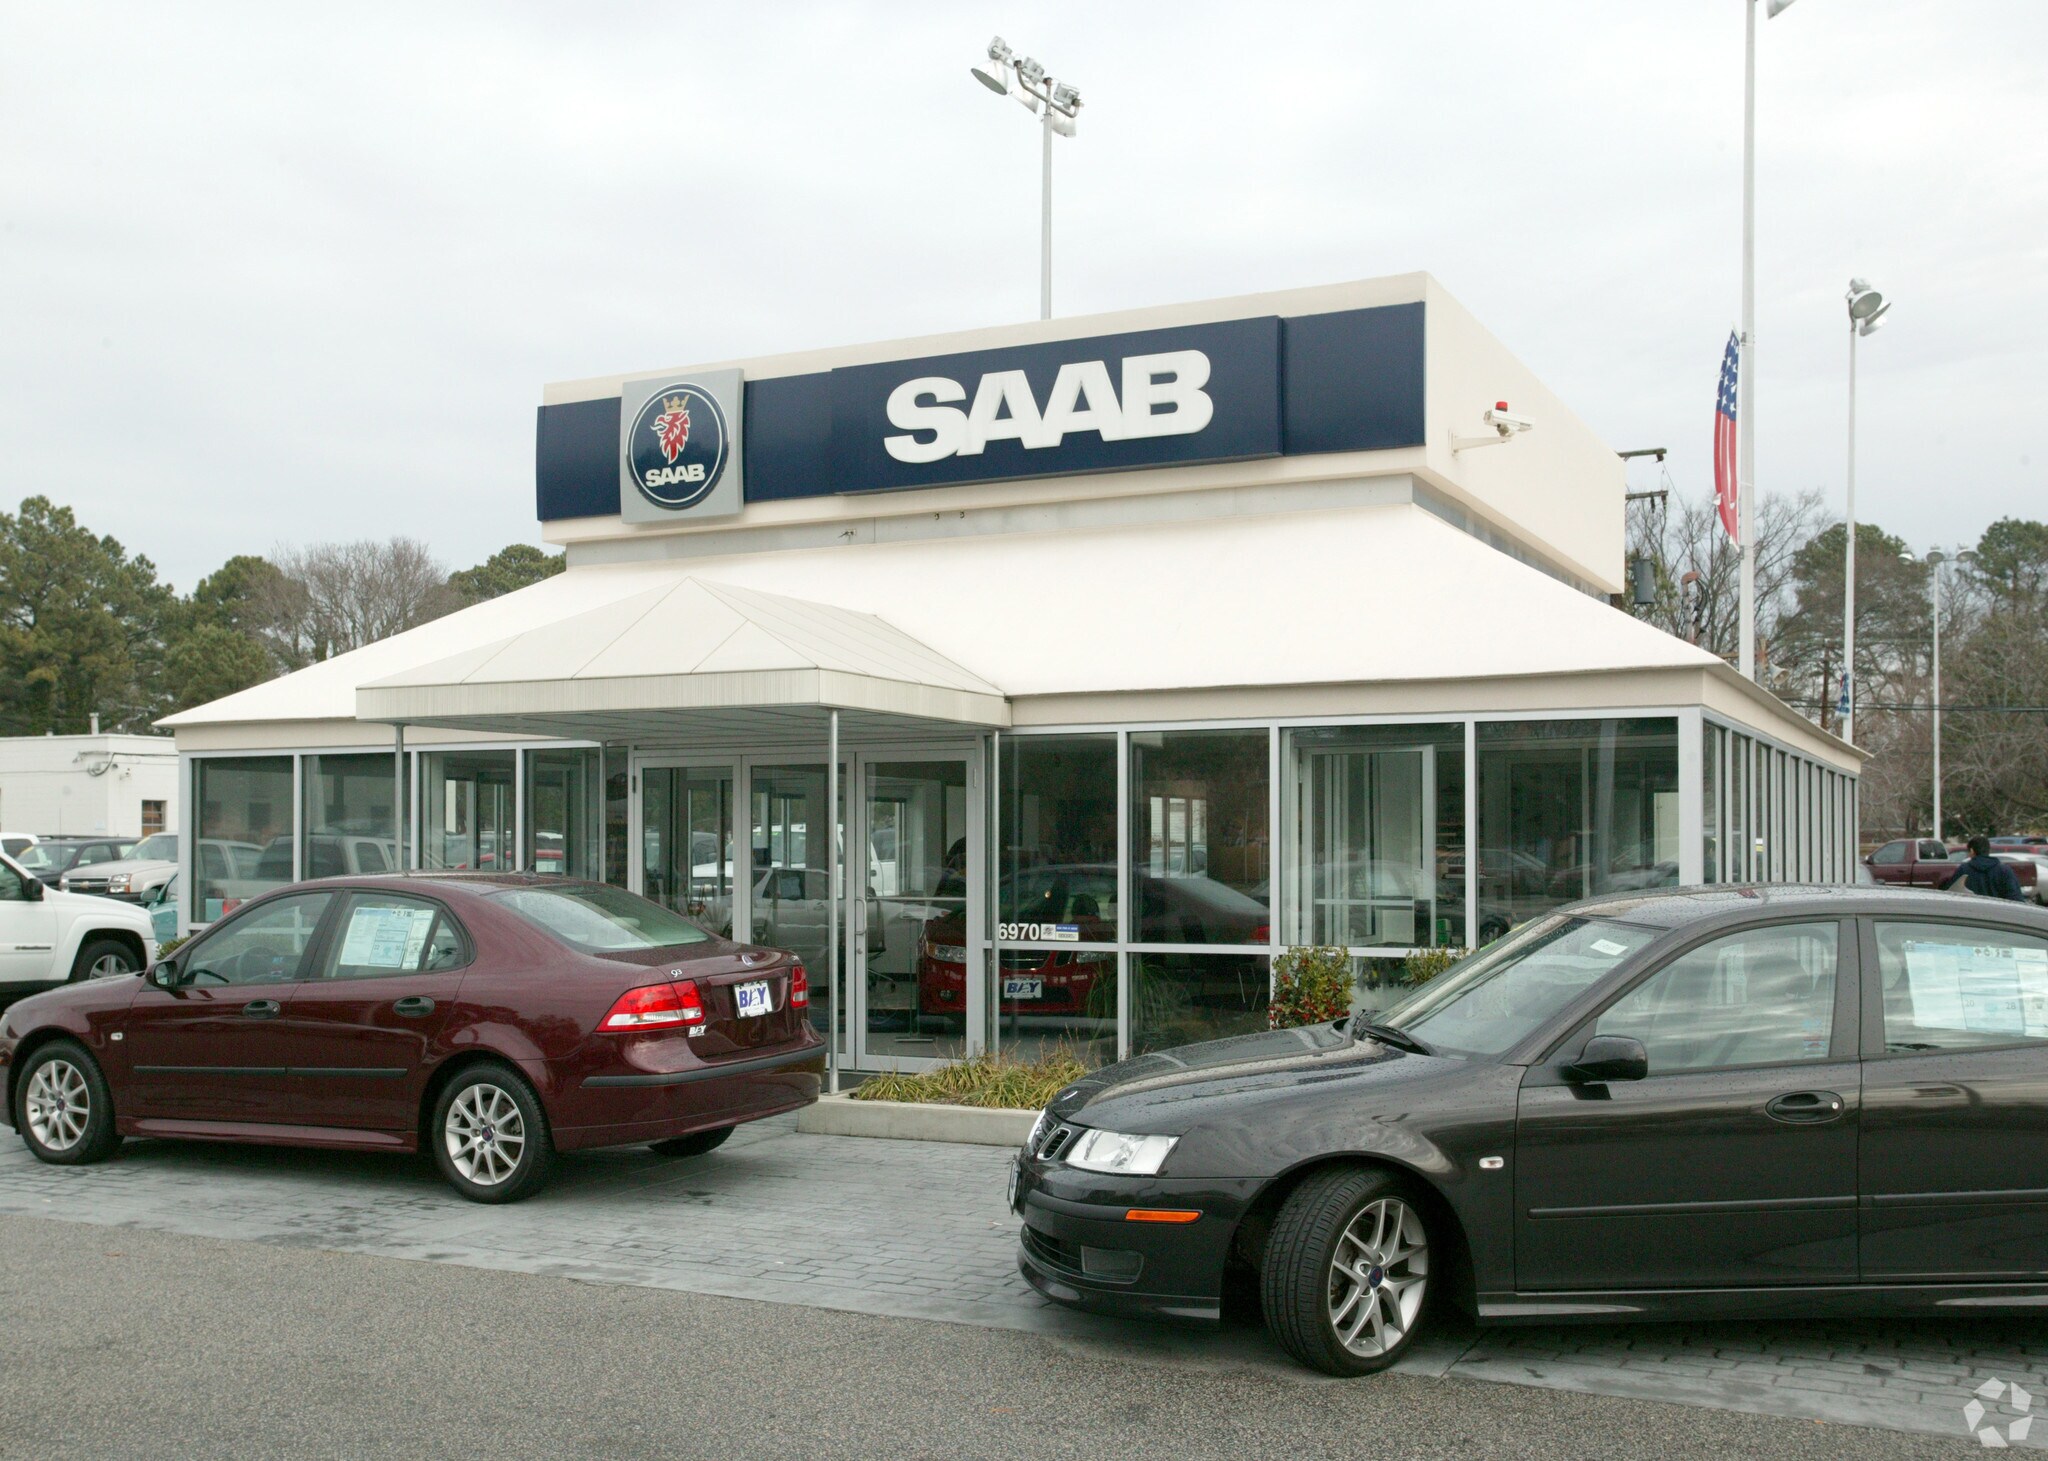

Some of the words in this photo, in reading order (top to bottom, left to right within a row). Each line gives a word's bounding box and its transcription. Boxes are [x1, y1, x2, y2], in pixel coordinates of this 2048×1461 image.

[884, 350, 1214, 463] SAAB
[645, 463, 706, 487] SAAB
[999, 923, 1039, 940] 6970
